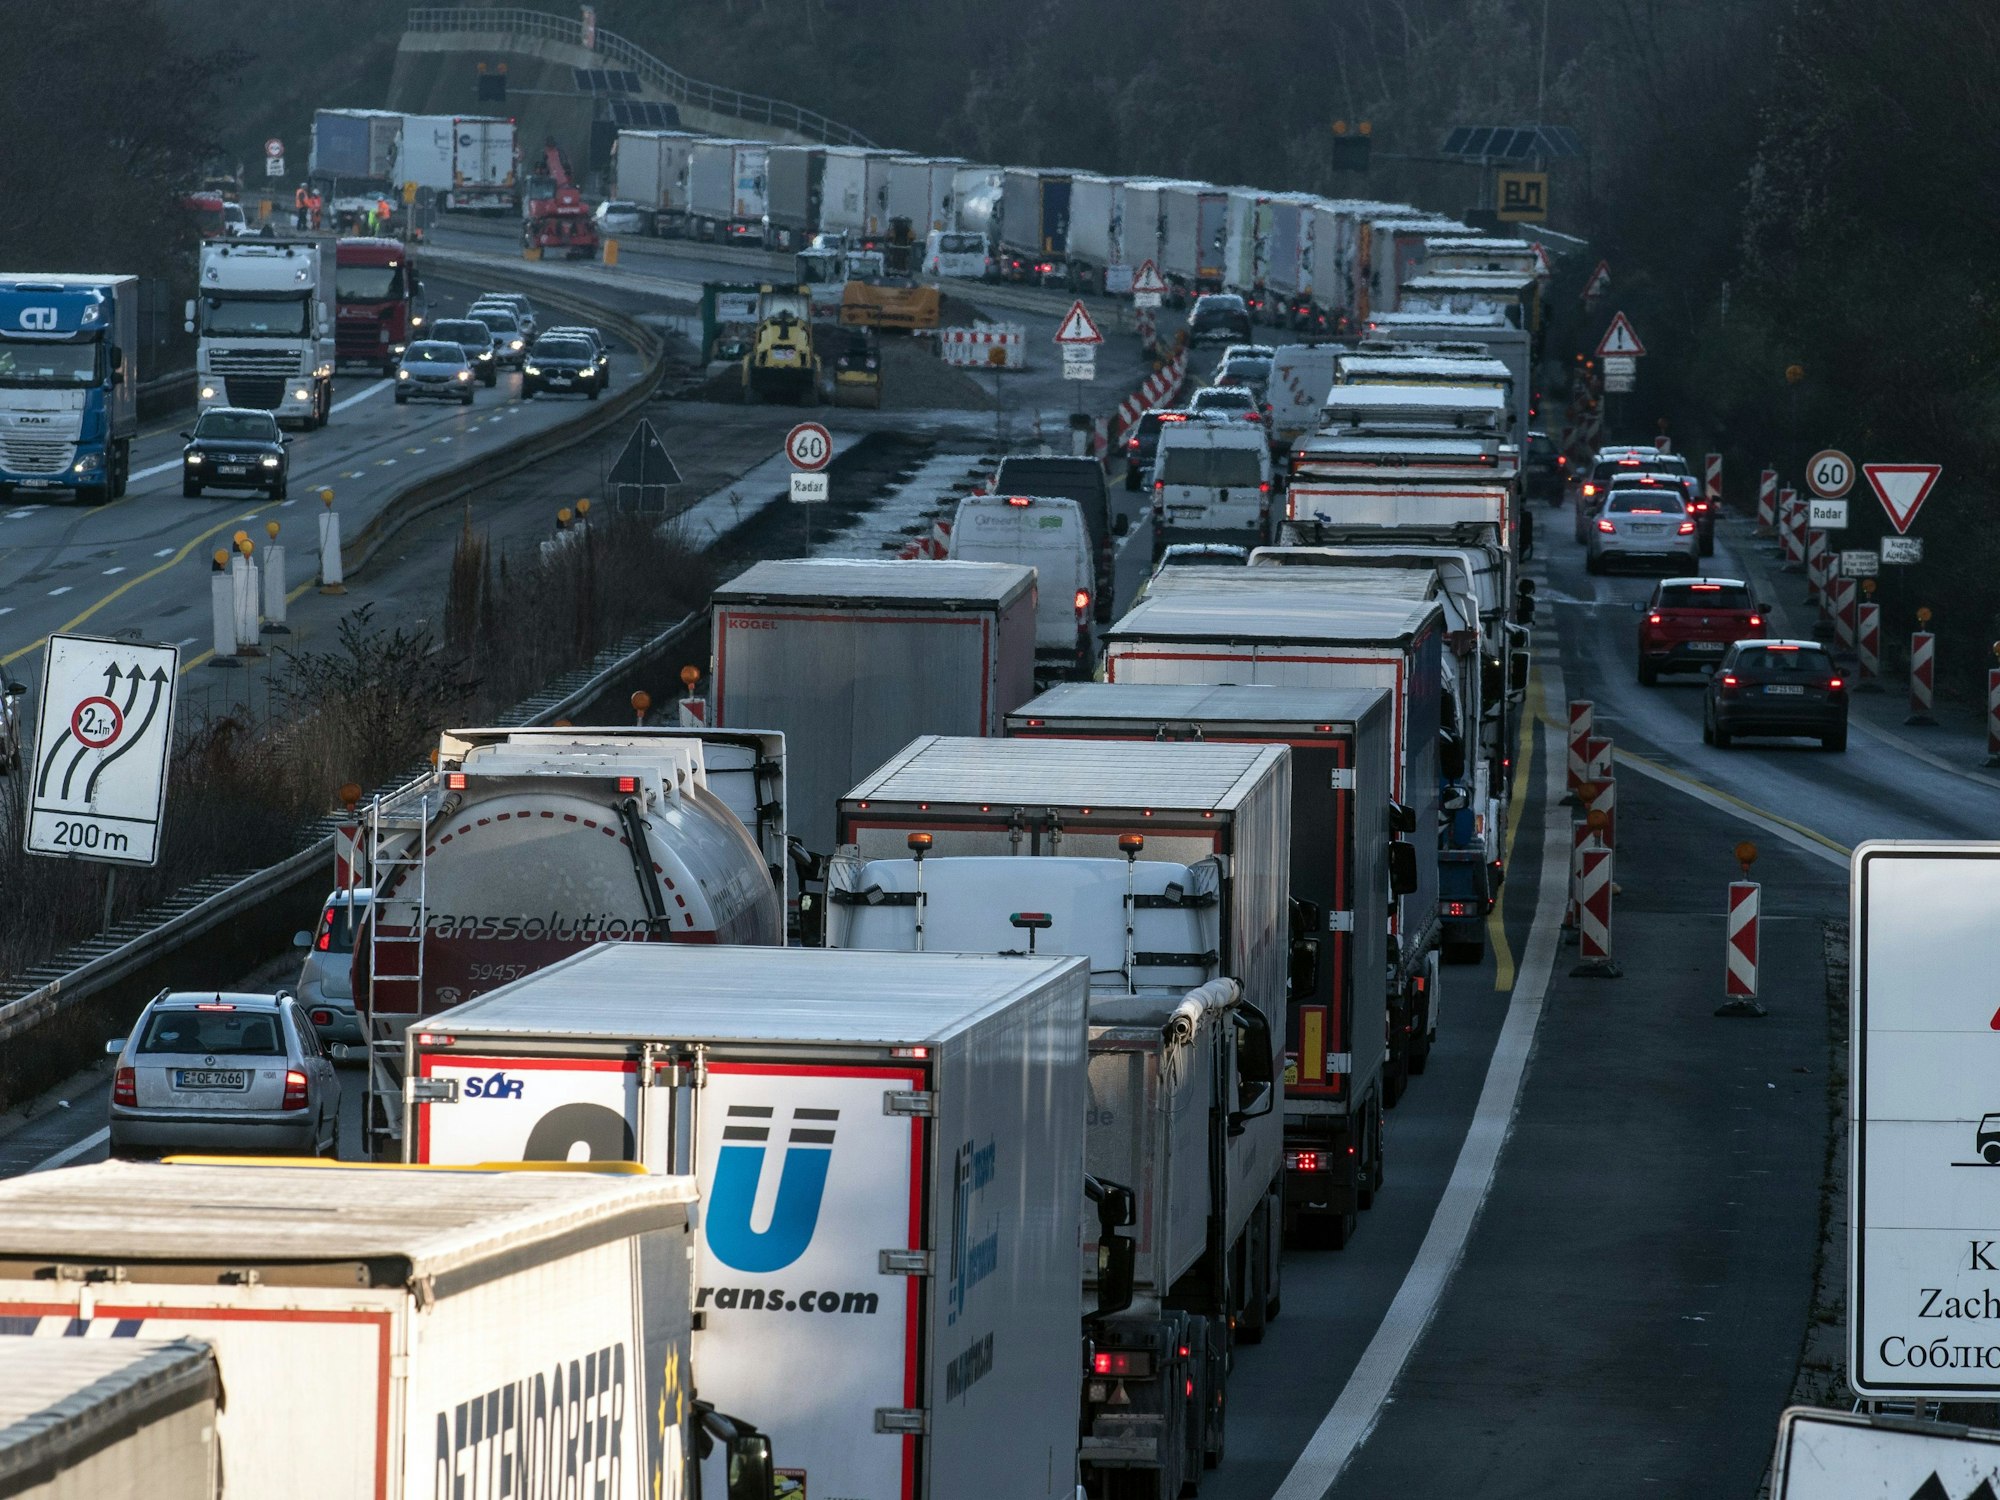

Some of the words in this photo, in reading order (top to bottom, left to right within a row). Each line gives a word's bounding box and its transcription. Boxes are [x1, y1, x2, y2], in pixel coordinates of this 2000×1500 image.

[797, 437, 822, 458] 60
[1818, 464, 1844, 484] 60
[794, 481, 823, 492] Radar
[1813, 507, 1843, 519] Radar
[728, 618, 778, 630] KÖGEL
[408, 906, 650, 943] Transsolution
[1918, 1288, 2000, 1319] Zach
